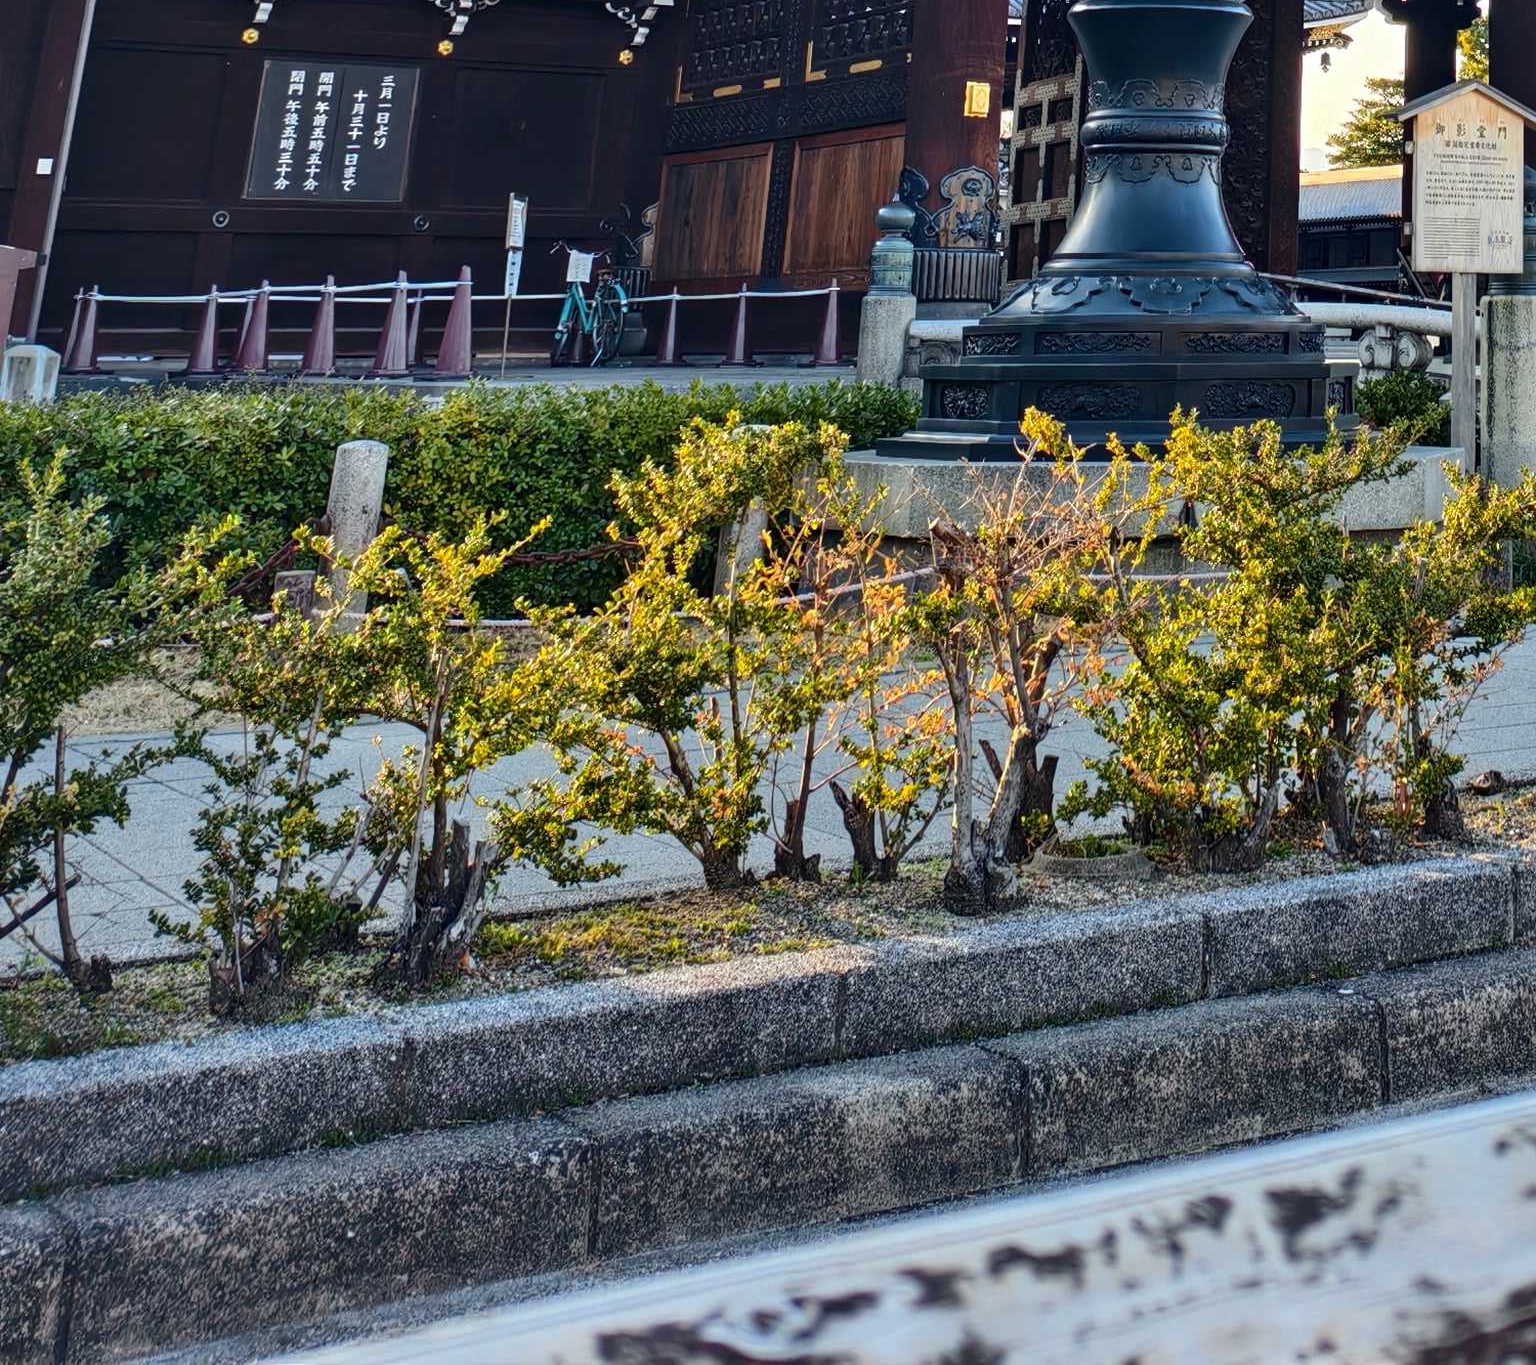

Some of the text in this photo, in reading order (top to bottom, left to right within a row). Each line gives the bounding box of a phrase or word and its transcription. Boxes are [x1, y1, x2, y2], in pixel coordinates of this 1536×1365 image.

[273, 99, 302, 191] 午後五時三十分
[302, 72, 335, 191] 開門 午前五時五十分
[341, 90, 369, 192] 十月三十一日まで
[373, 75, 396, 150] 三月一日より
